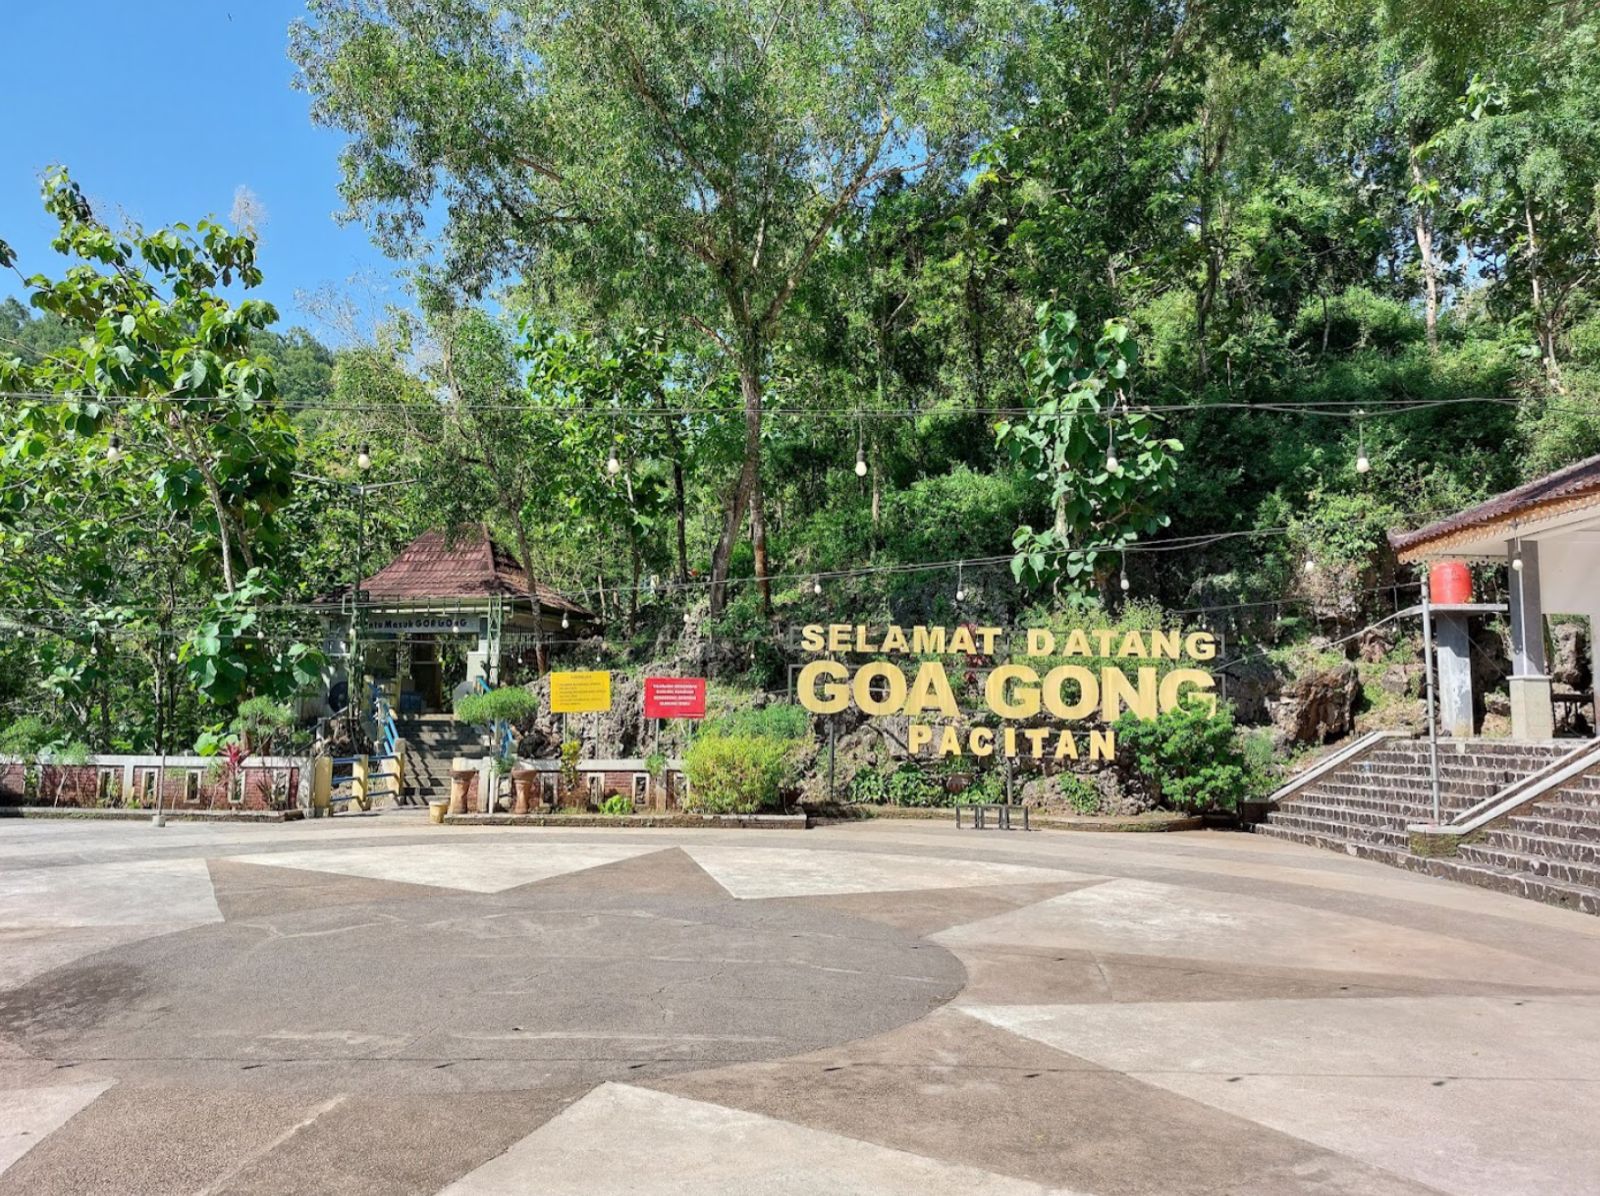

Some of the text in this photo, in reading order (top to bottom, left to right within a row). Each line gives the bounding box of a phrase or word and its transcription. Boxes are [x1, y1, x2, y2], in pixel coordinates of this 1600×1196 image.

[801, 624, 1217, 660] SELAMAT DATANG
[797, 660, 1218, 721] GOA GONG
[908, 726, 1116, 761] PACITAN
